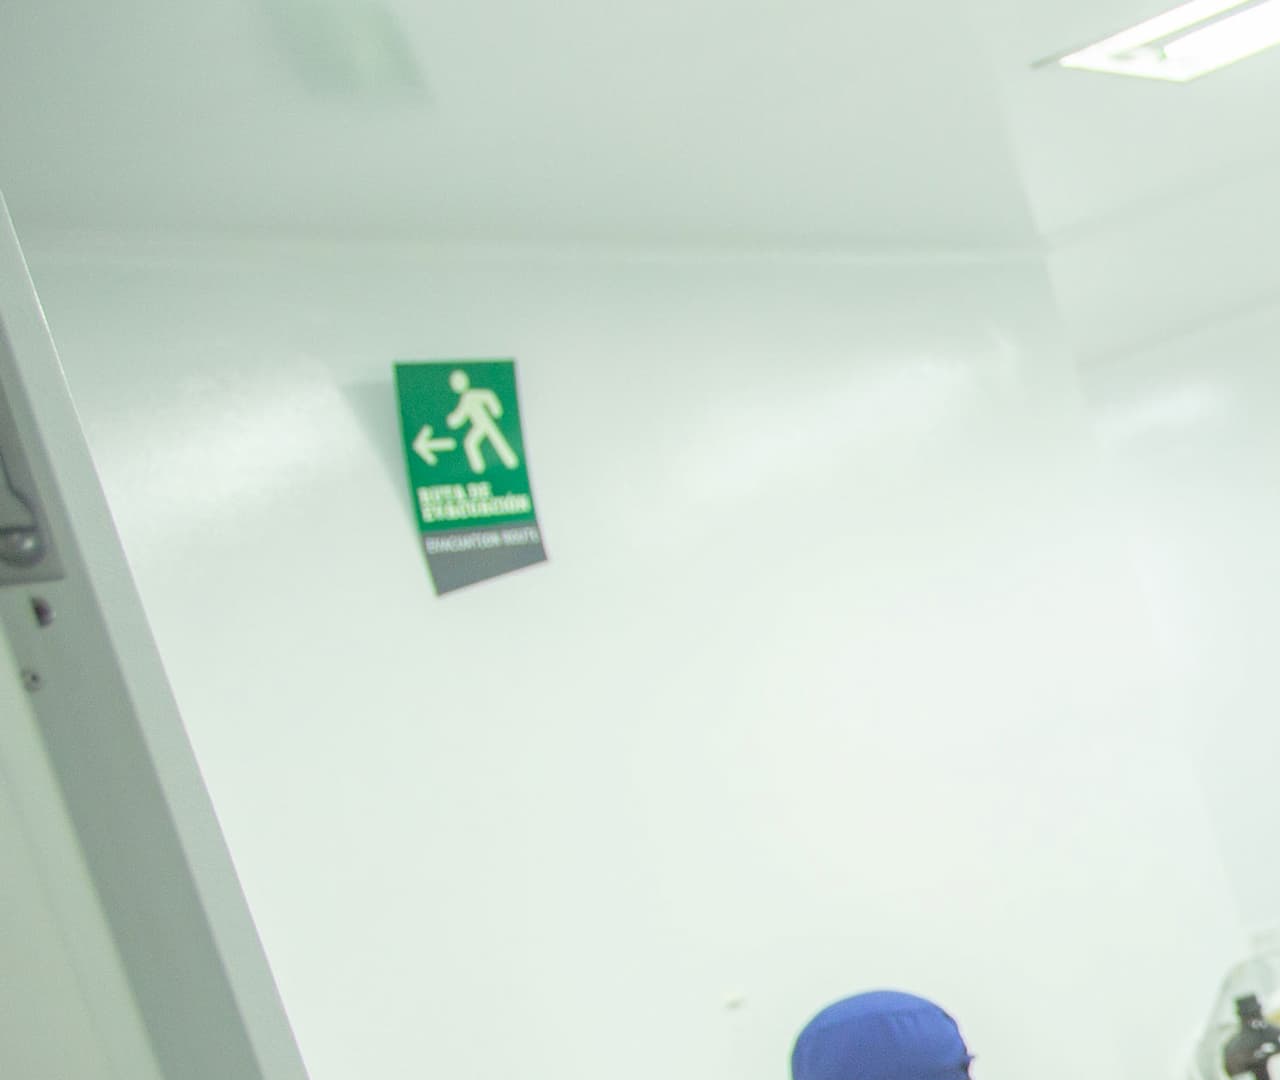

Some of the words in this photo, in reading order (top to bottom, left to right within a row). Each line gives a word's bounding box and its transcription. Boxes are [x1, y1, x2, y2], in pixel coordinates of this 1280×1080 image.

[417, 485, 465, 502] RUTA
[467, 481, 491, 499] DE
[421, 491, 532, 522] EVACUACIÓN
